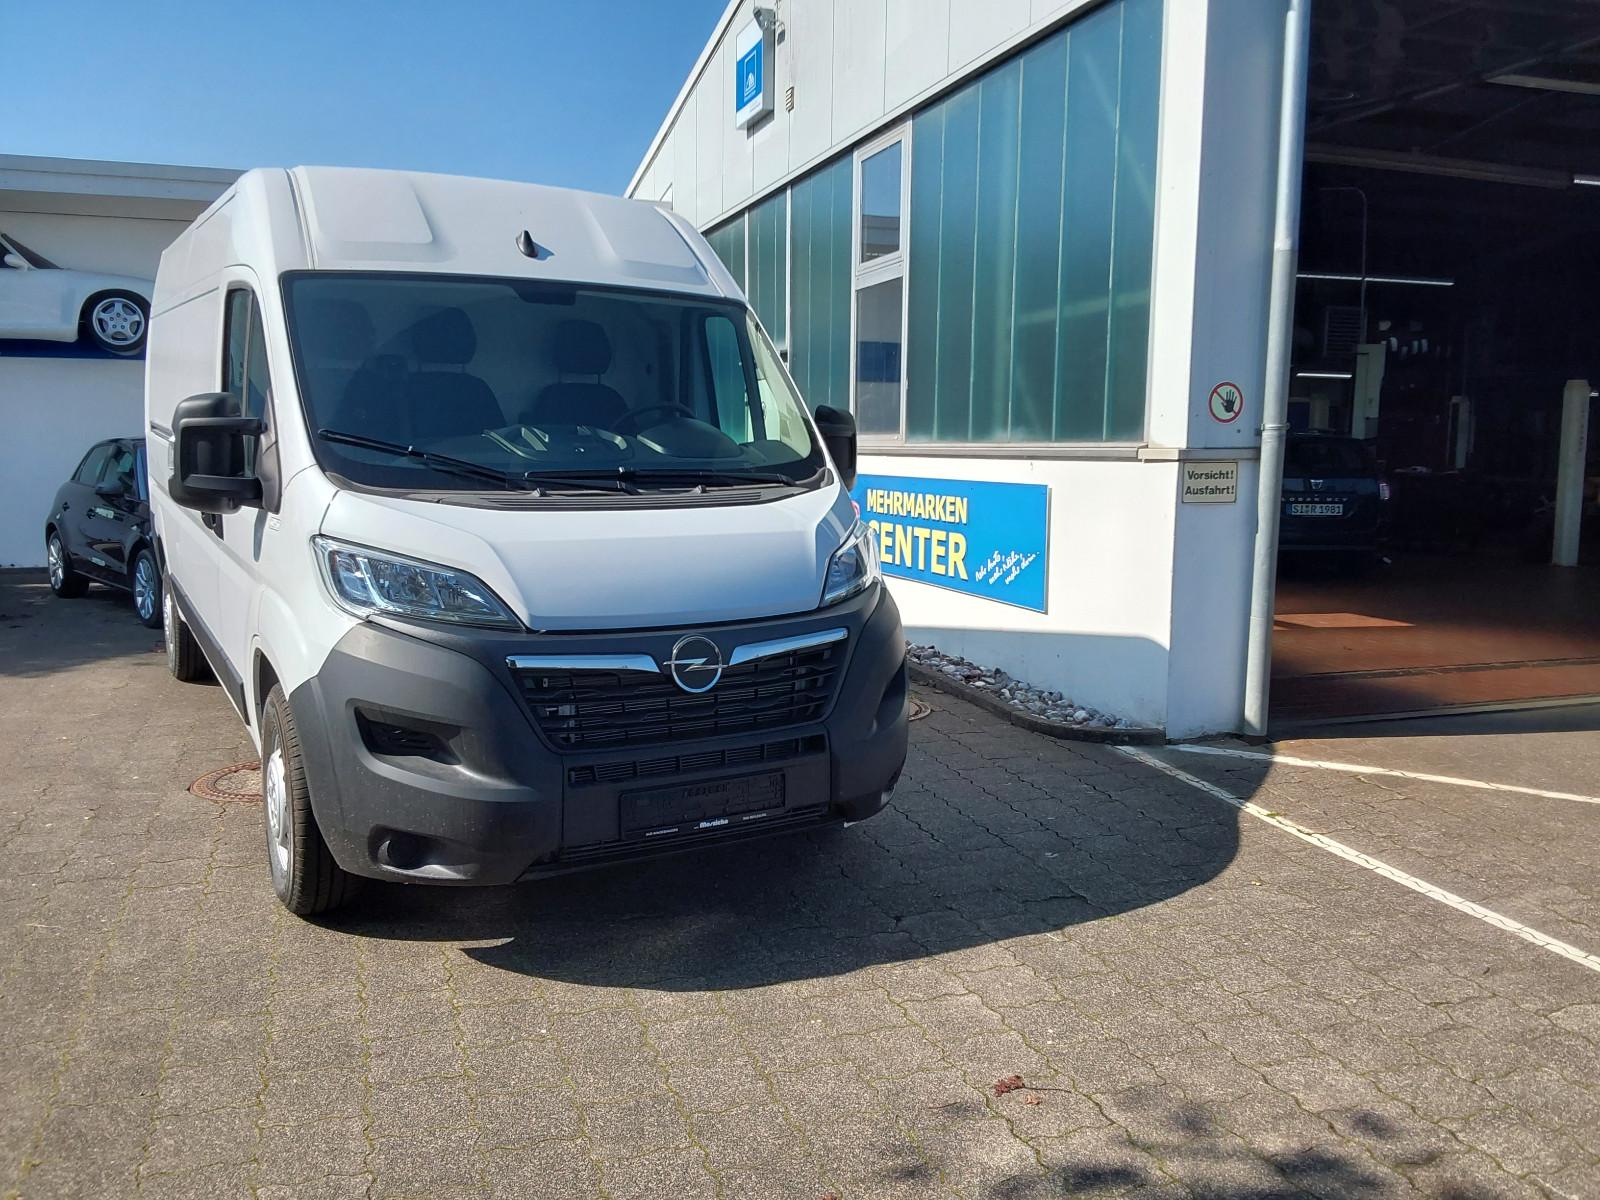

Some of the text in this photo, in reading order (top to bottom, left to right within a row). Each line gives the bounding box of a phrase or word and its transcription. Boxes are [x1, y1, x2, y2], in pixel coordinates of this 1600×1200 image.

[1187, 470, 1234, 480] Vorsicht!
[1185, 485, 1235, 495] Ausfahrt!
[866, 488, 968, 524] MEHRMARKEN
